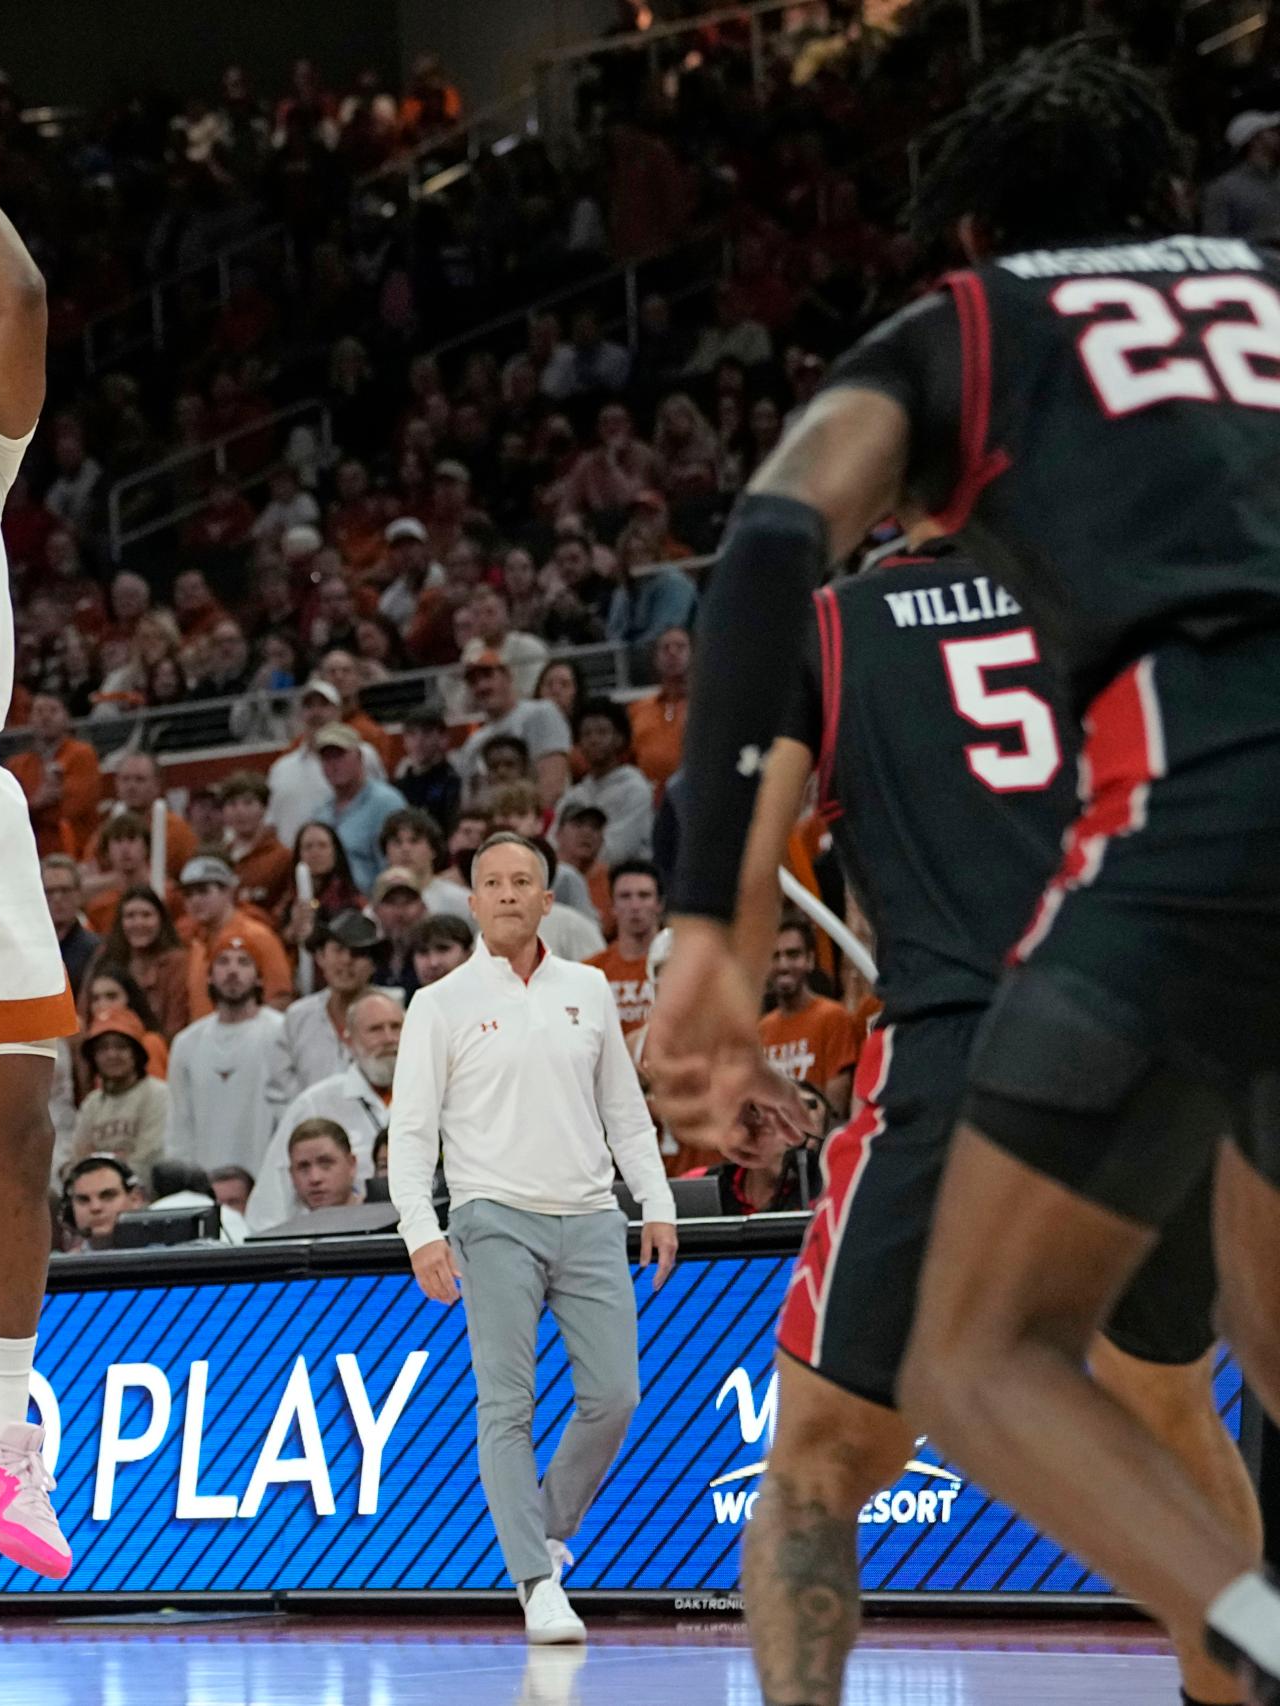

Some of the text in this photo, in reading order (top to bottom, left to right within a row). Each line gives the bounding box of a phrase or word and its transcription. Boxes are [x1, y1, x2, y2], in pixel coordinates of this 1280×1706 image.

[1048, 275, 1280, 420] 22
[883, 576, 1023, 628] WILLIA
[938, 626, 1064, 794] 5
[92, 1350, 430, 1521] PLAY
[857, 1489, 959, 1524] ESORT
[673, 1597, 747, 1610] DAKTRONI
